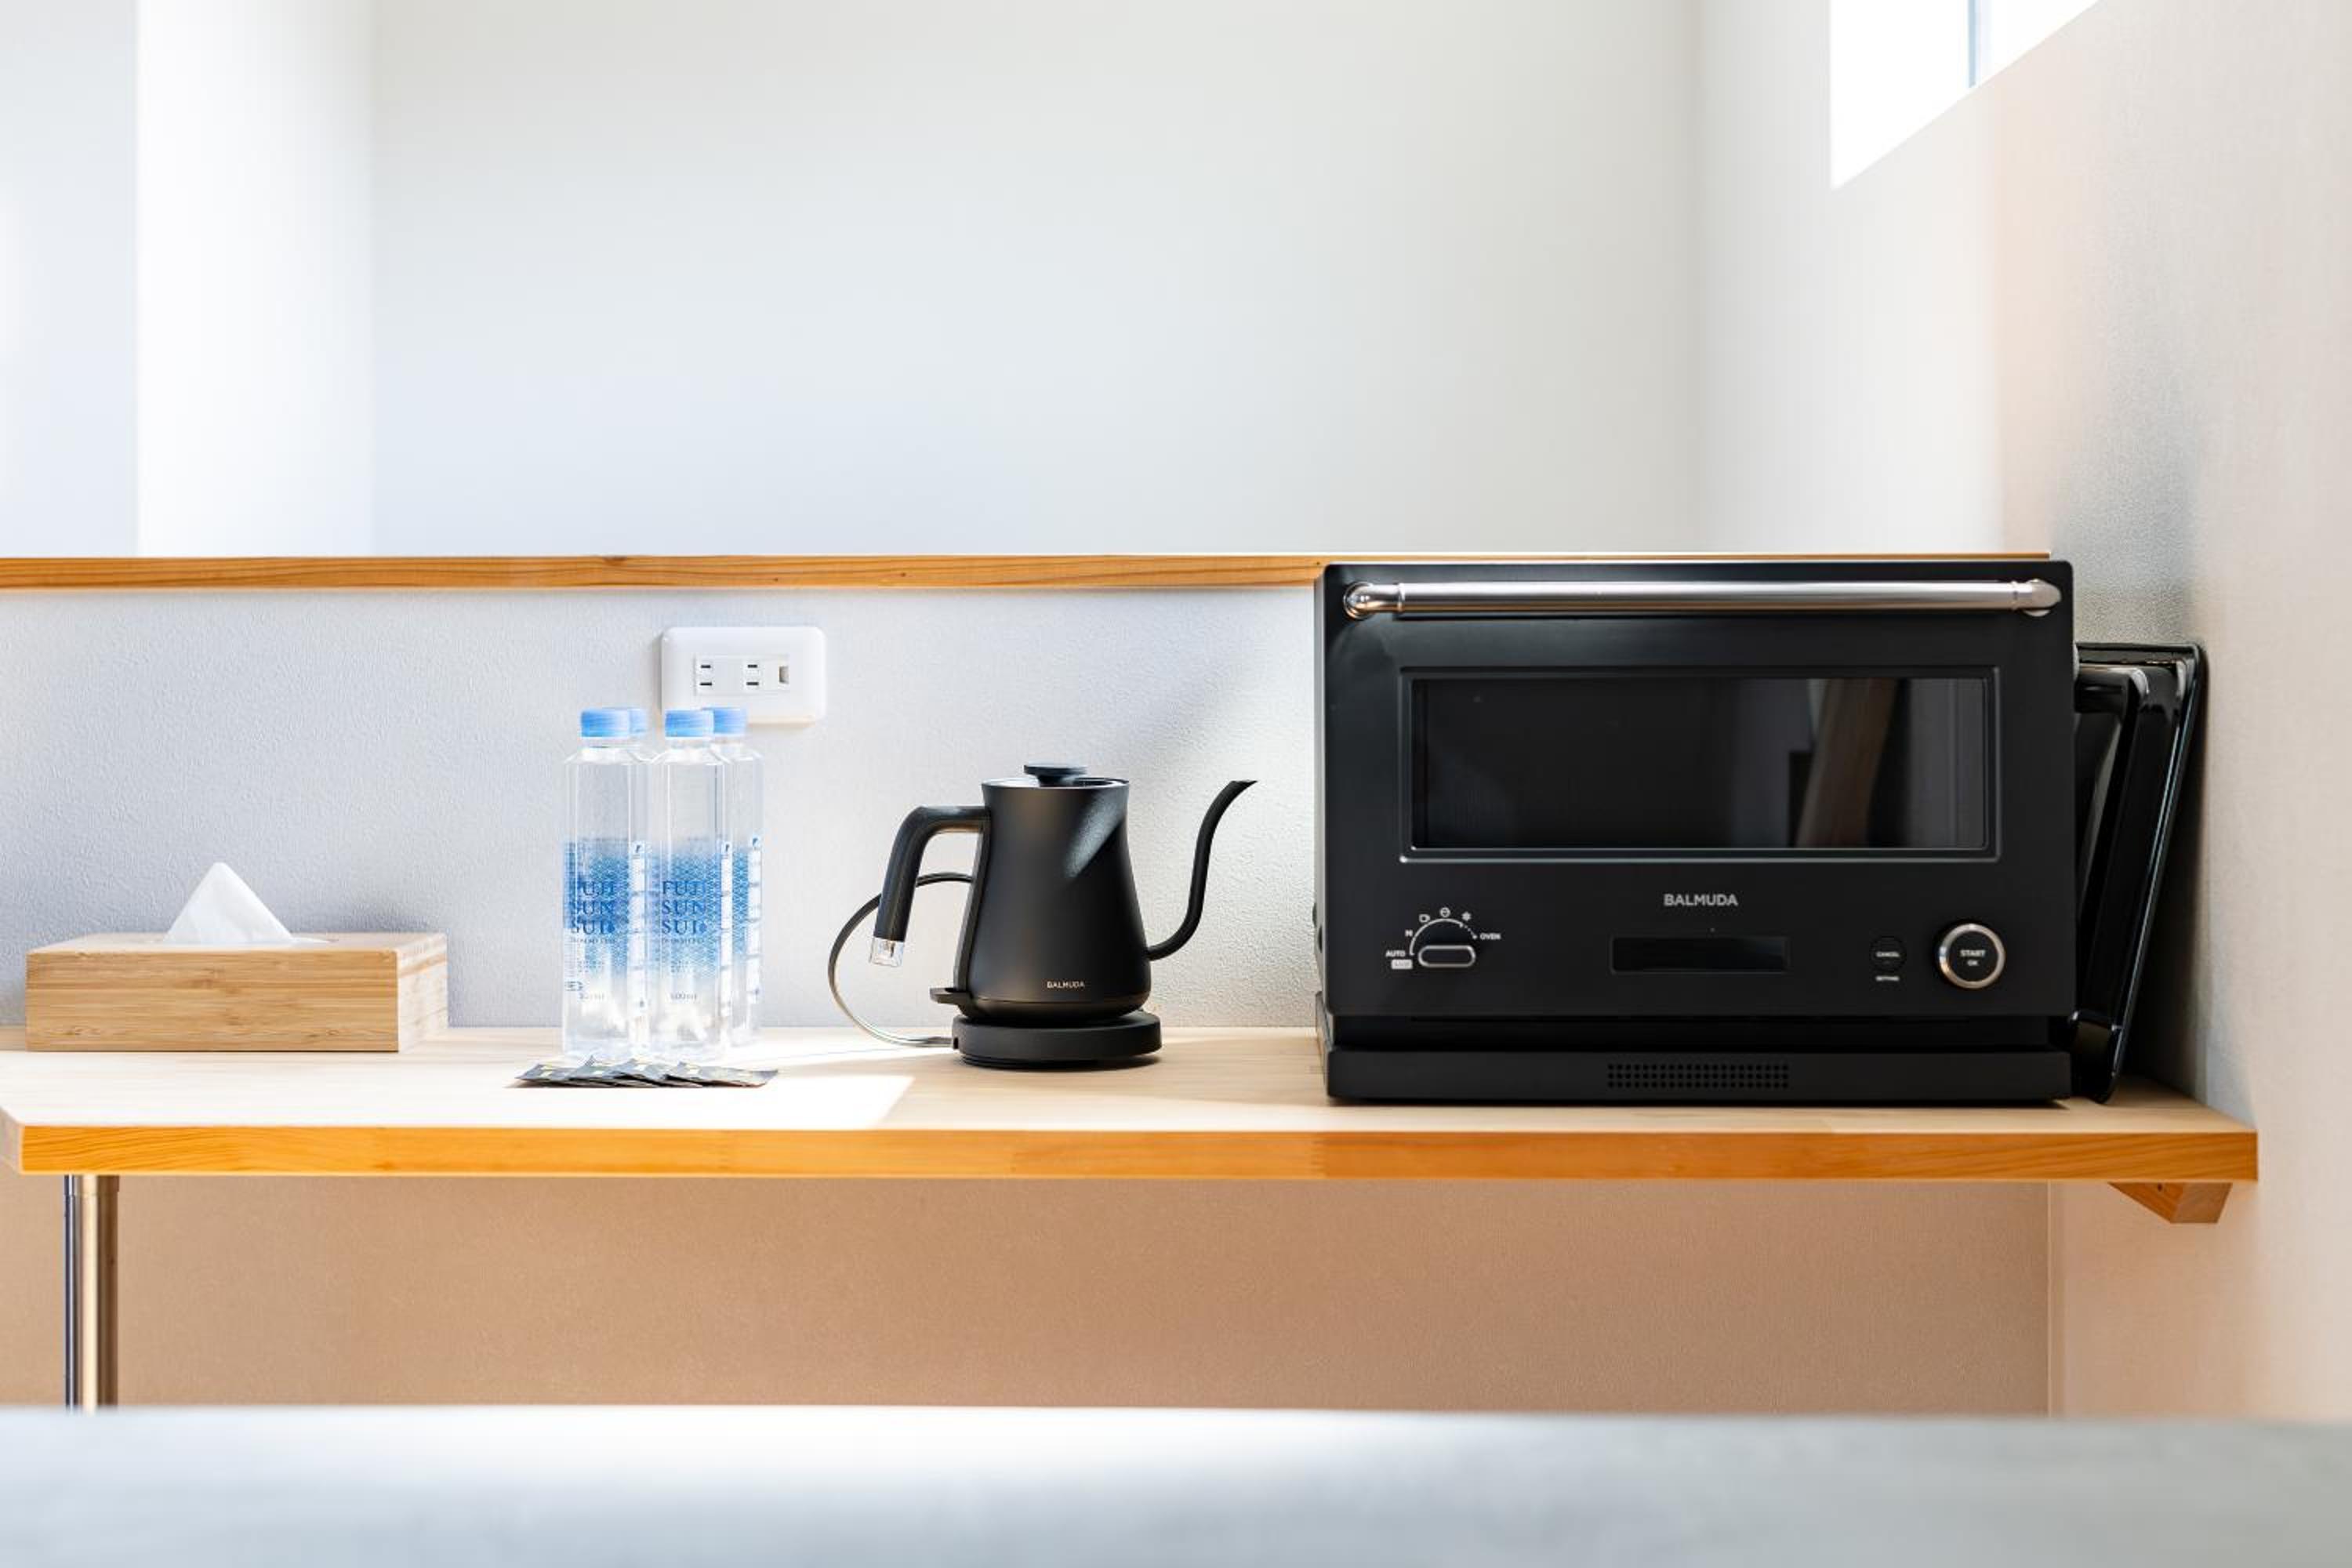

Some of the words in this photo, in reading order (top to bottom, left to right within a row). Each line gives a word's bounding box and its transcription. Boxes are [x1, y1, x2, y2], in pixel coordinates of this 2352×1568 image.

[662, 880, 706, 895] FUJI
[1664, 893, 1738, 906] BALMUDA
[662, 900, 706, 916] SUN
[662, 919, 696, 935] SUI
